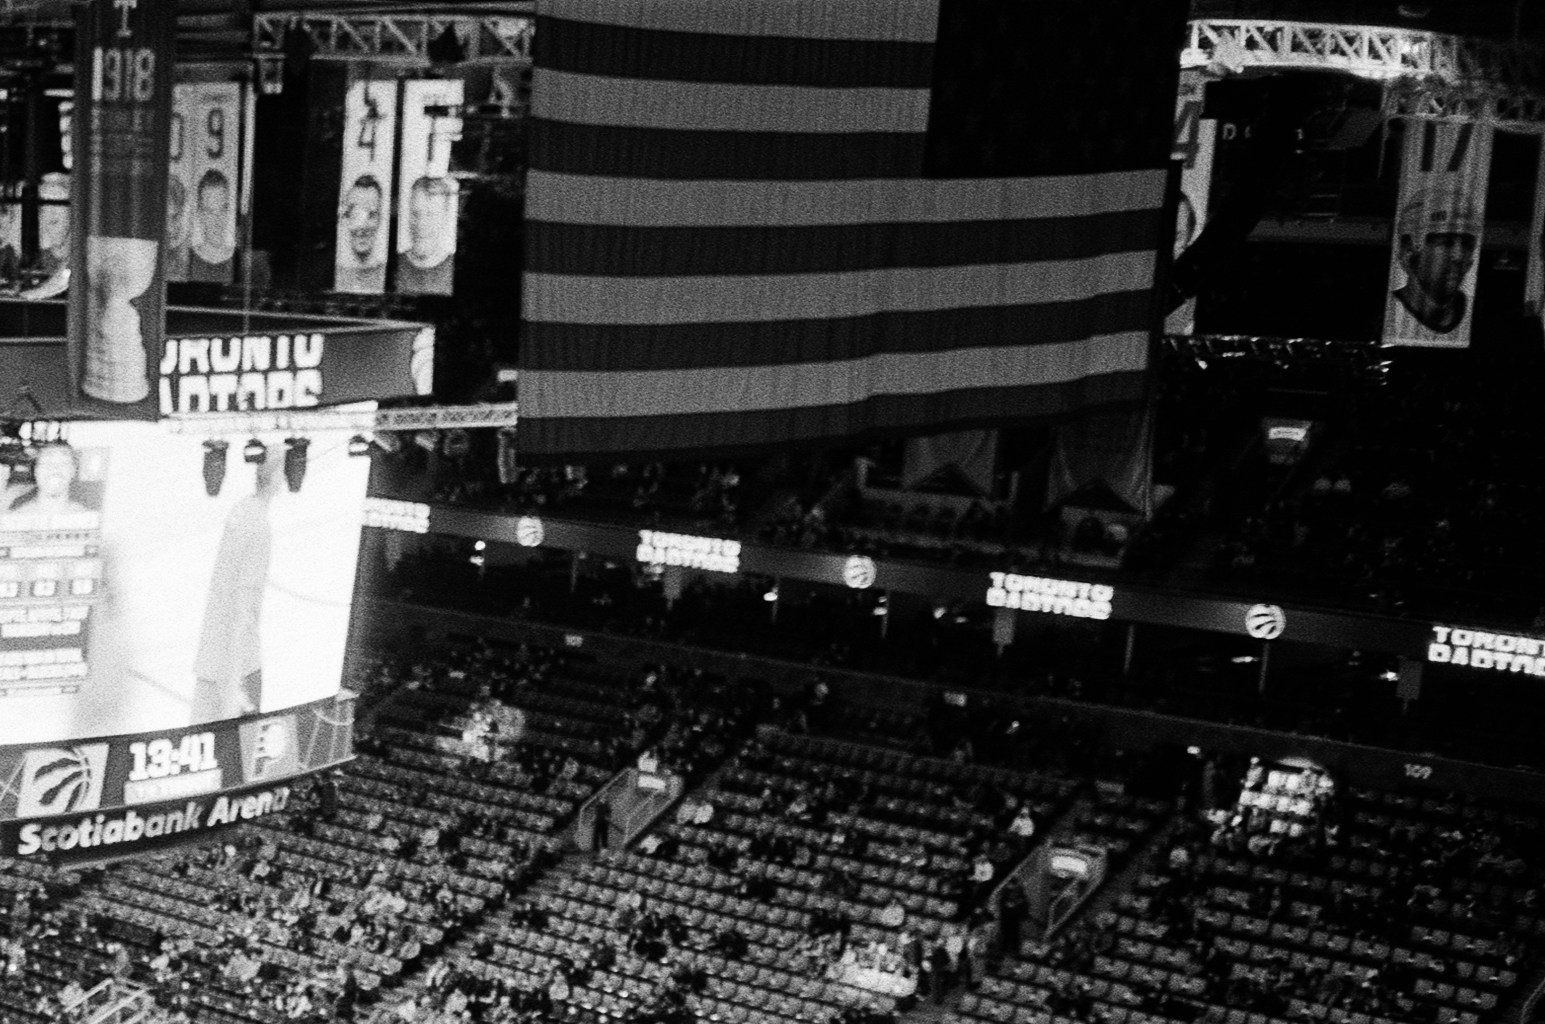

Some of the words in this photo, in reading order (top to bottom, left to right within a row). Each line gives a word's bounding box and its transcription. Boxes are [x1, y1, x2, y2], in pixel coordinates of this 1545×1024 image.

[92, 47, 155, 101] 1918
[207, 107, 224, 159] 9
[1421, 121, 1474, 172] 17
[128, 731, 218, 782] 13:41
[17, 802, 204, 856] Scotiabank
[206, 786, 290, 827] Arena
